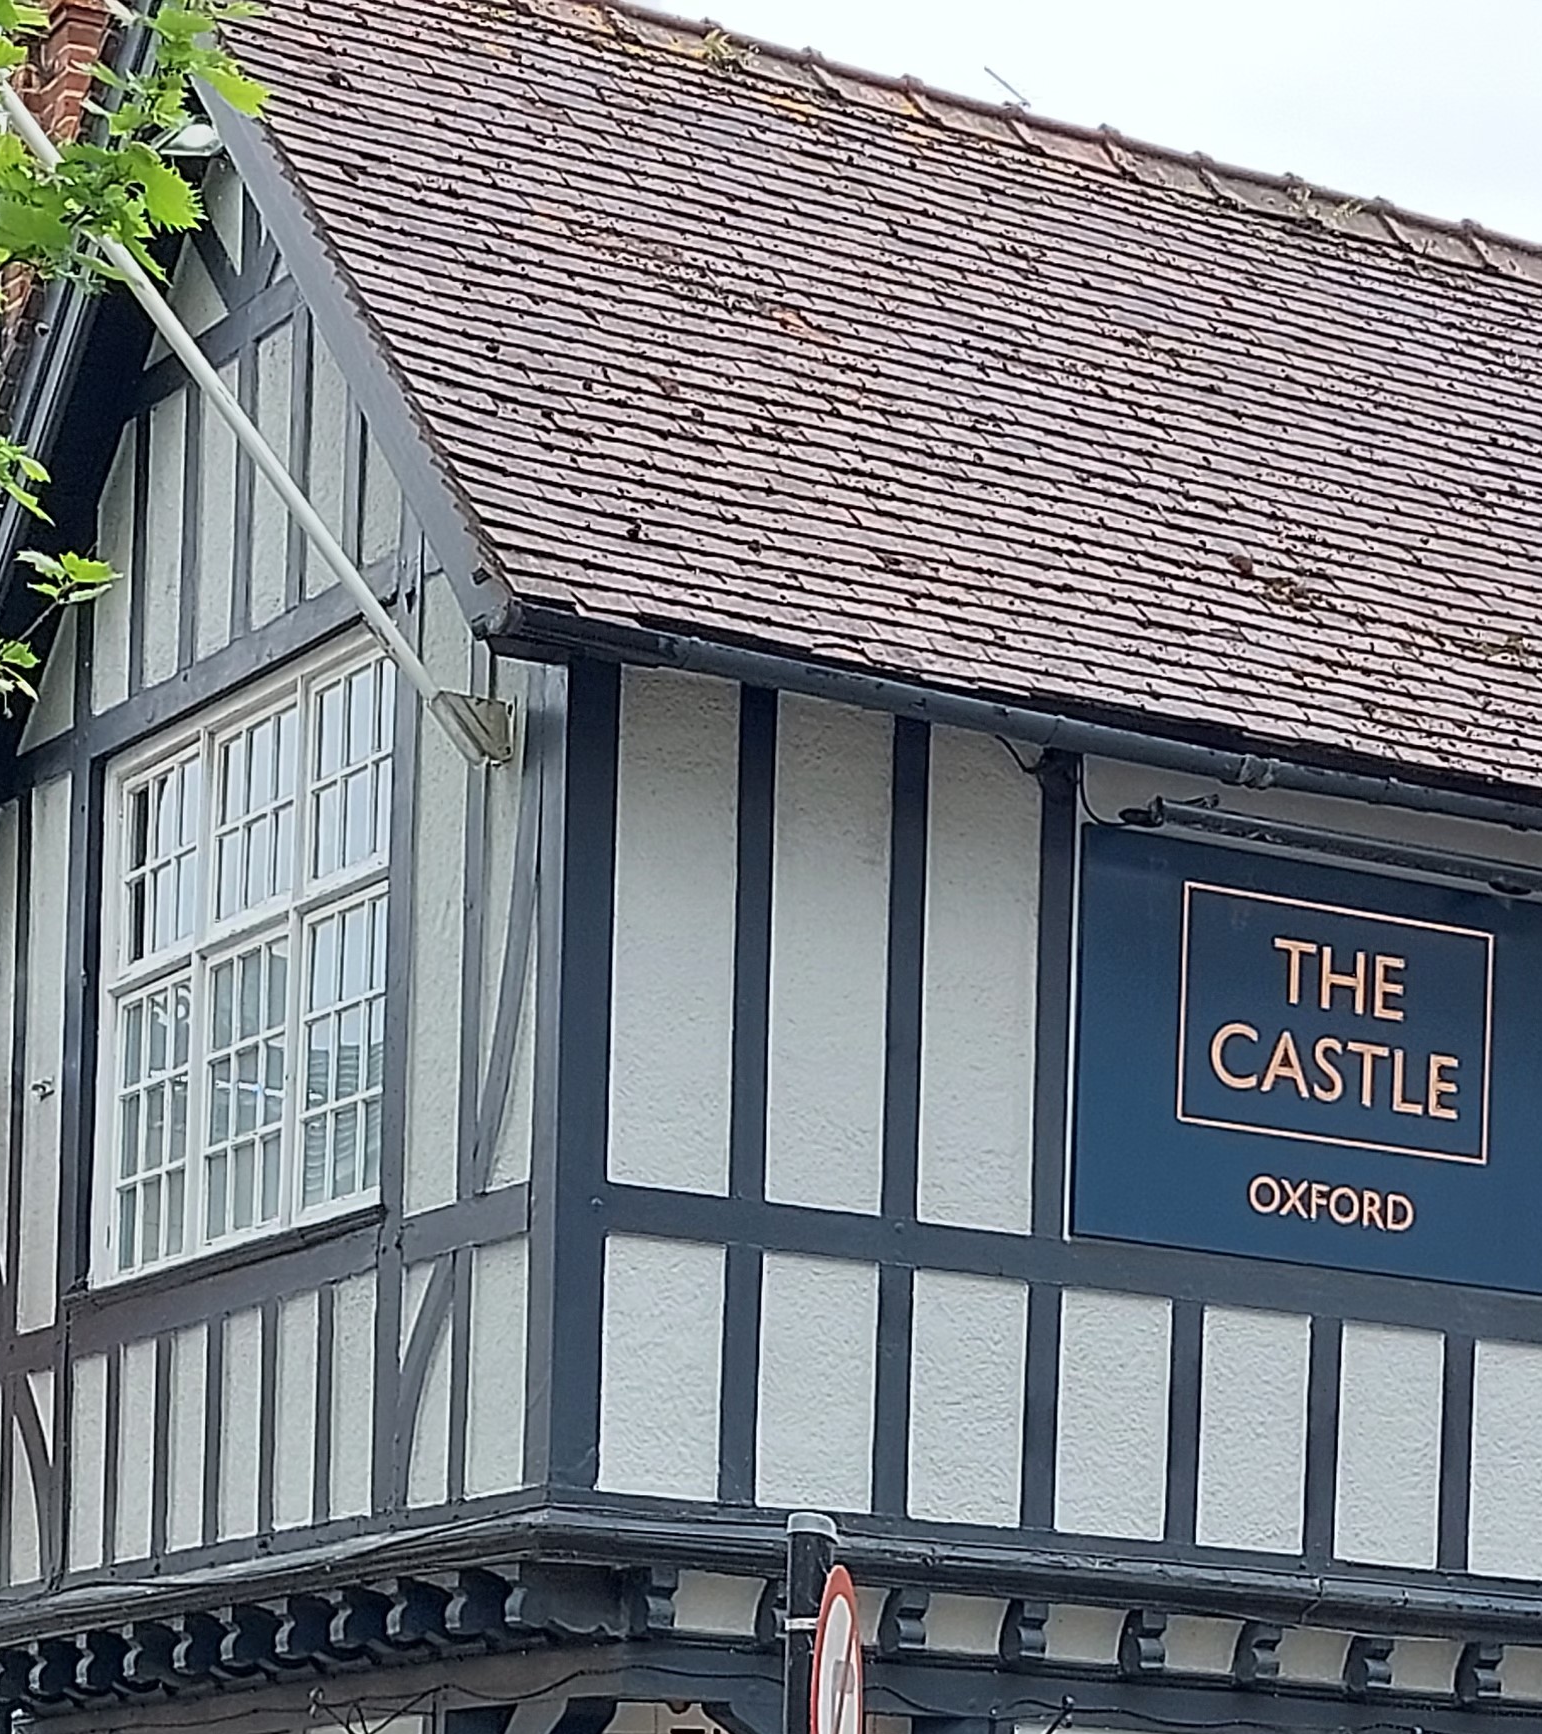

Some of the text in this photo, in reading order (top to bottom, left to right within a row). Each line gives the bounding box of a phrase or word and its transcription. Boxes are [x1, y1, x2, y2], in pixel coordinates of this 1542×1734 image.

[1274, 936, 1406, 1022] THE
[1210, 1021, 1460, 1121] CASTLE
[1248, 1174, 1415, 1233] OXFORD
